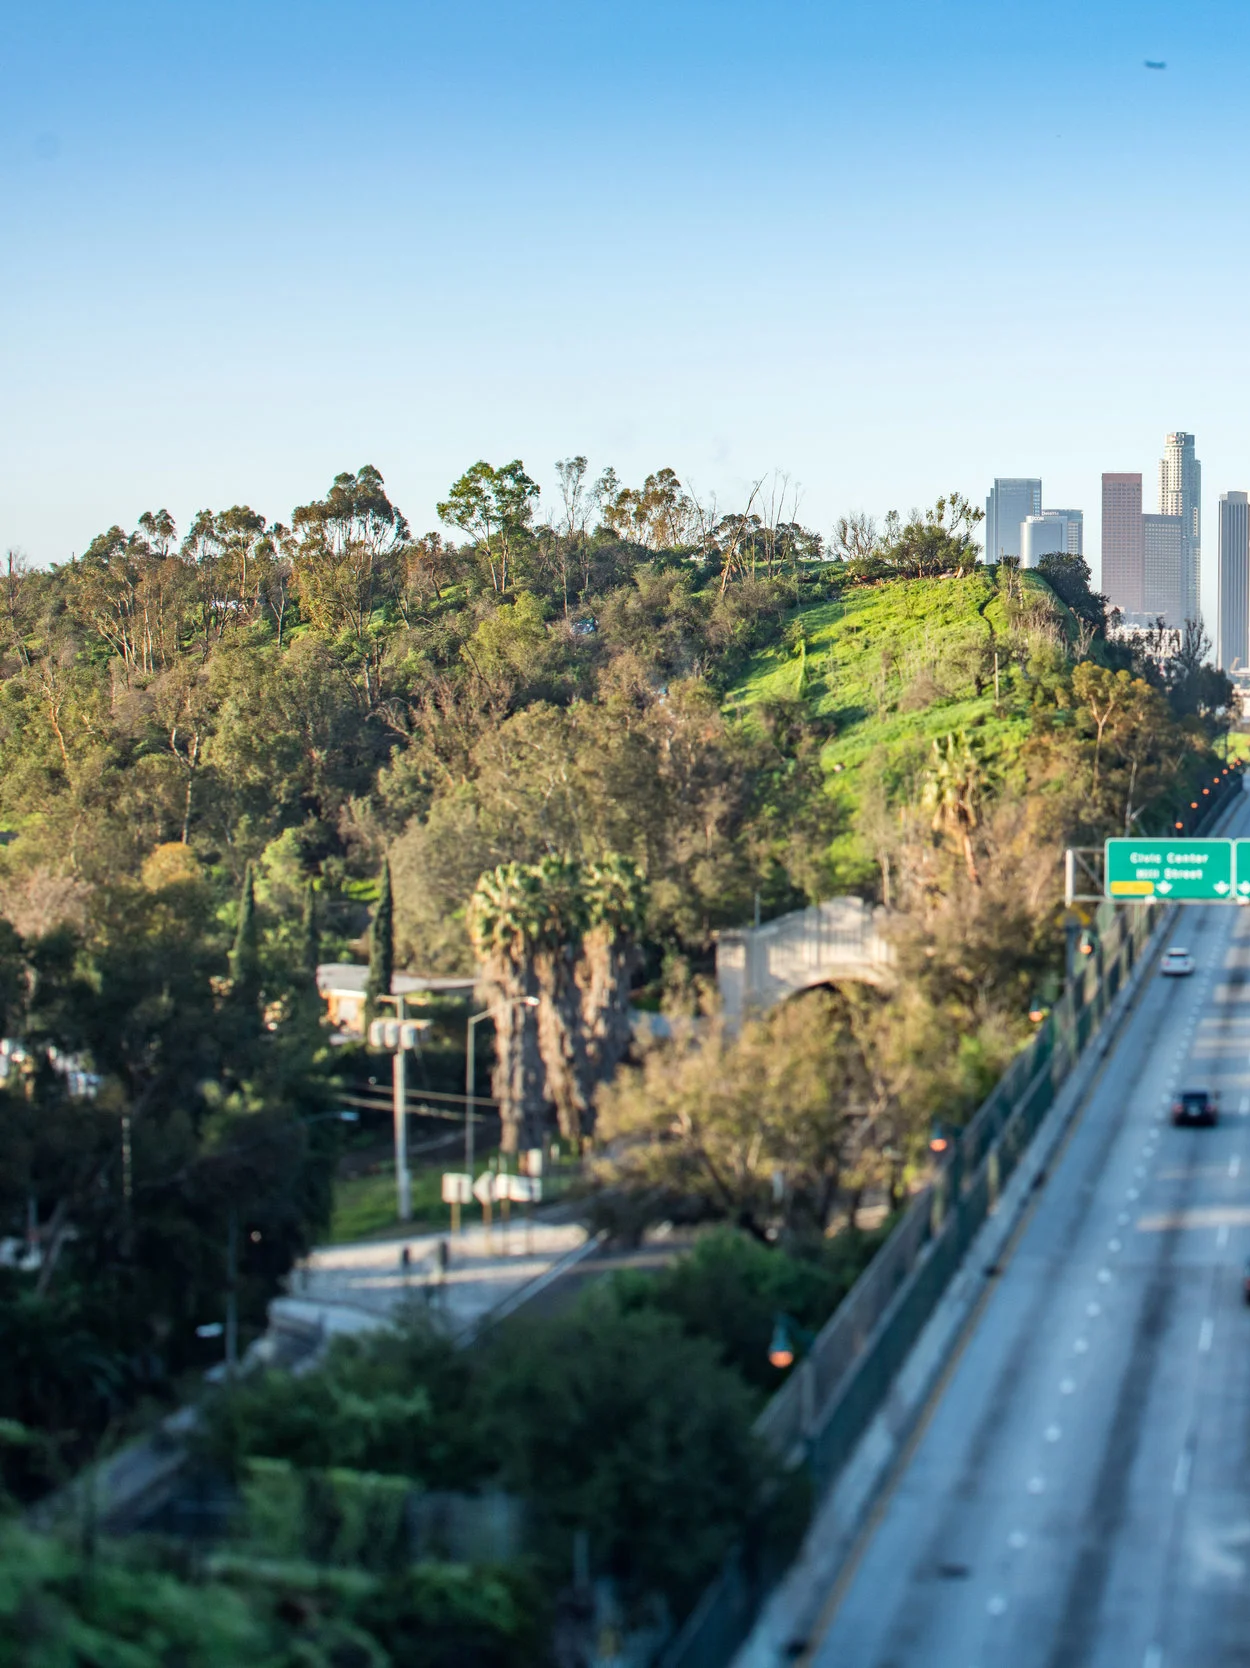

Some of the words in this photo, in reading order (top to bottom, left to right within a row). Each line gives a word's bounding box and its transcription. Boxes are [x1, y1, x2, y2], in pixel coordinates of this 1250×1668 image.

[1130, 852, 1162, 864] Civic
[1166, 852, 1209, 864] Center
[1136, 868, 1160, 879] Hill
[1164, 867, 1203, 880] Street
